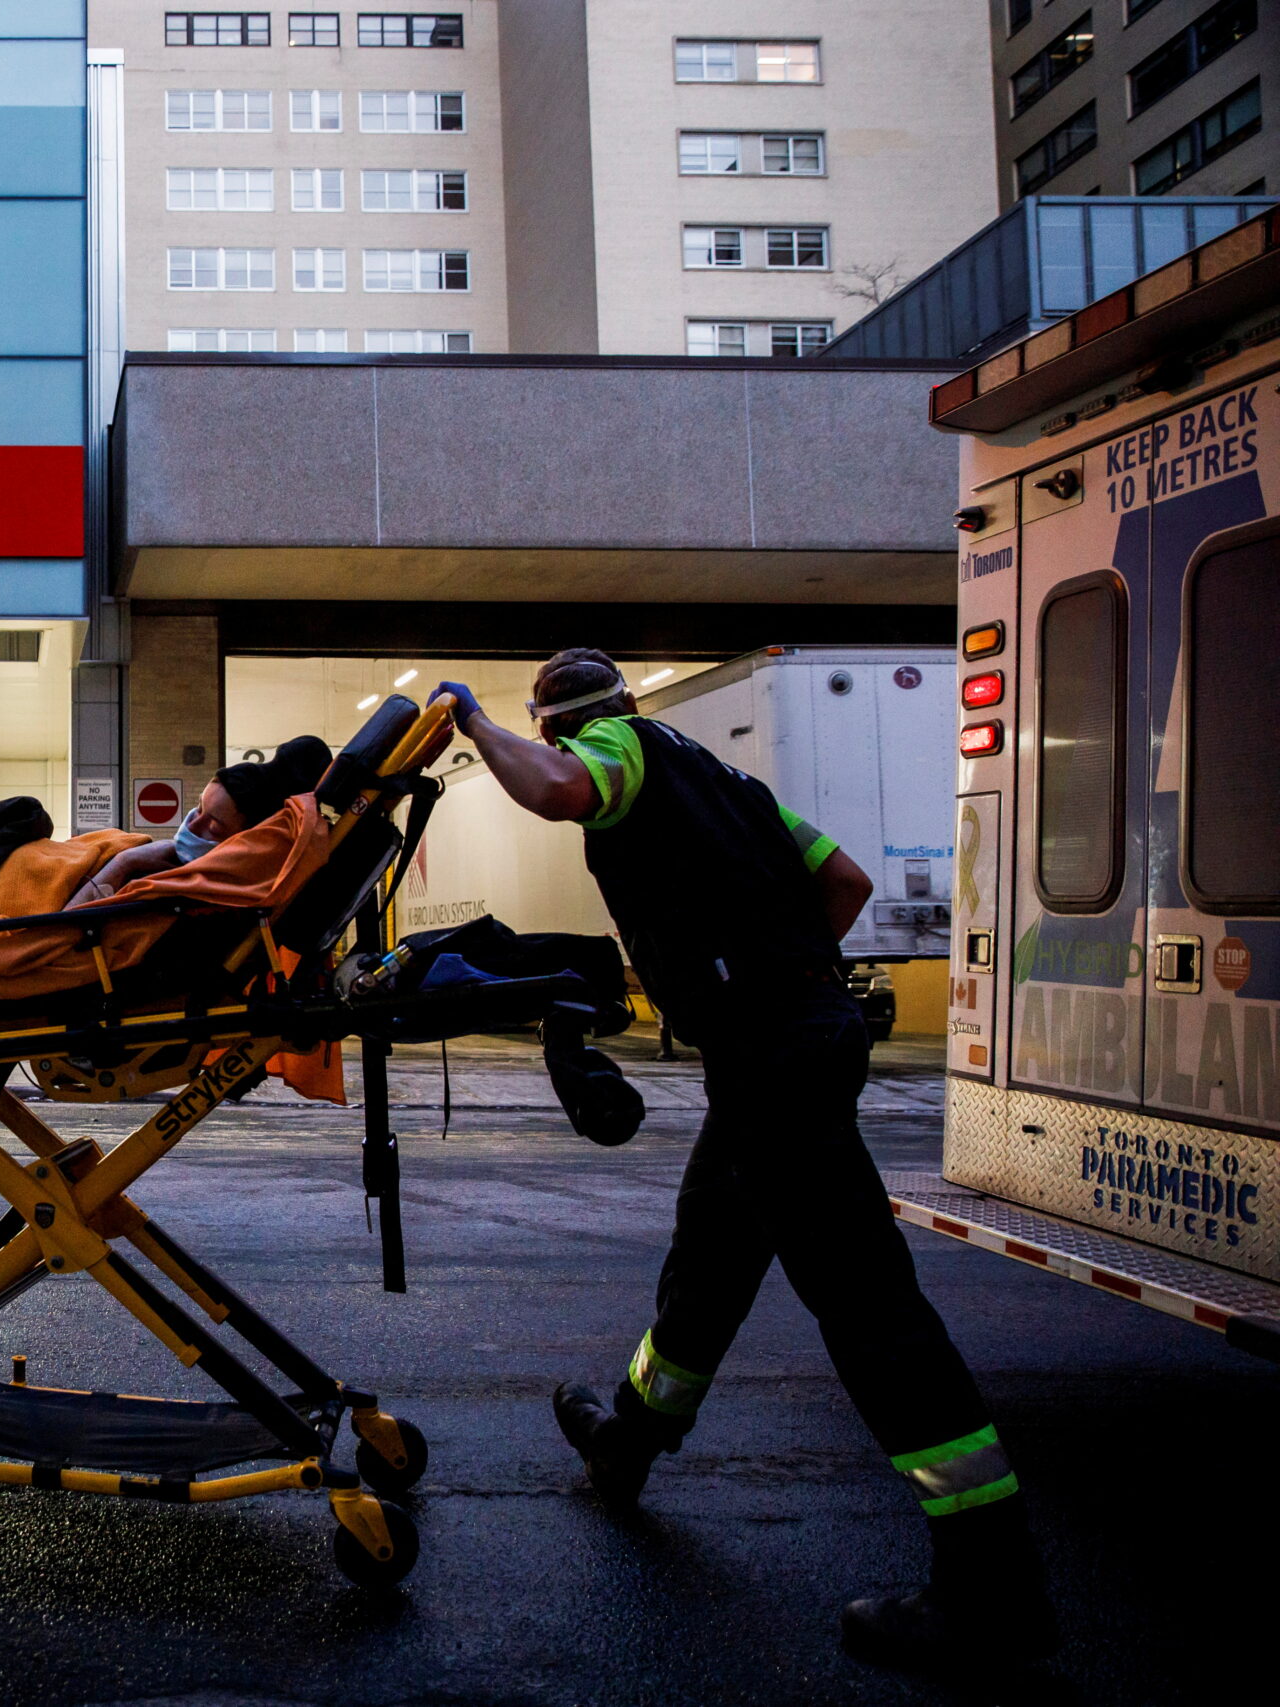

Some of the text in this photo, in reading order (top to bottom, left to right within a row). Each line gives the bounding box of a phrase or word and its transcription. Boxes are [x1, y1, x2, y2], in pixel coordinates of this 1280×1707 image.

[1107, 386, 1258, 477] KEEP BACK
[1107, 429, 1258, 513] 10 METRES
[972, 546, 1013, 579] TORONTO
[884, 846, 944, 857] MountSinai
[429, 903, 450, 924] LINEN
[451, 900, 486, 922] SYSTEMS
[1038, 939, 1144, 978] HYBRID
[1218, 948, 1246, 965] STOP
[155, 1041, 254, 1141] stryker
[1098, 1127, 1239, 1176] TORONTO
[1082, 1147, 1258, 1225] PARAMEDIC
[1094, 1188, 1240, 1246] SERVICES
